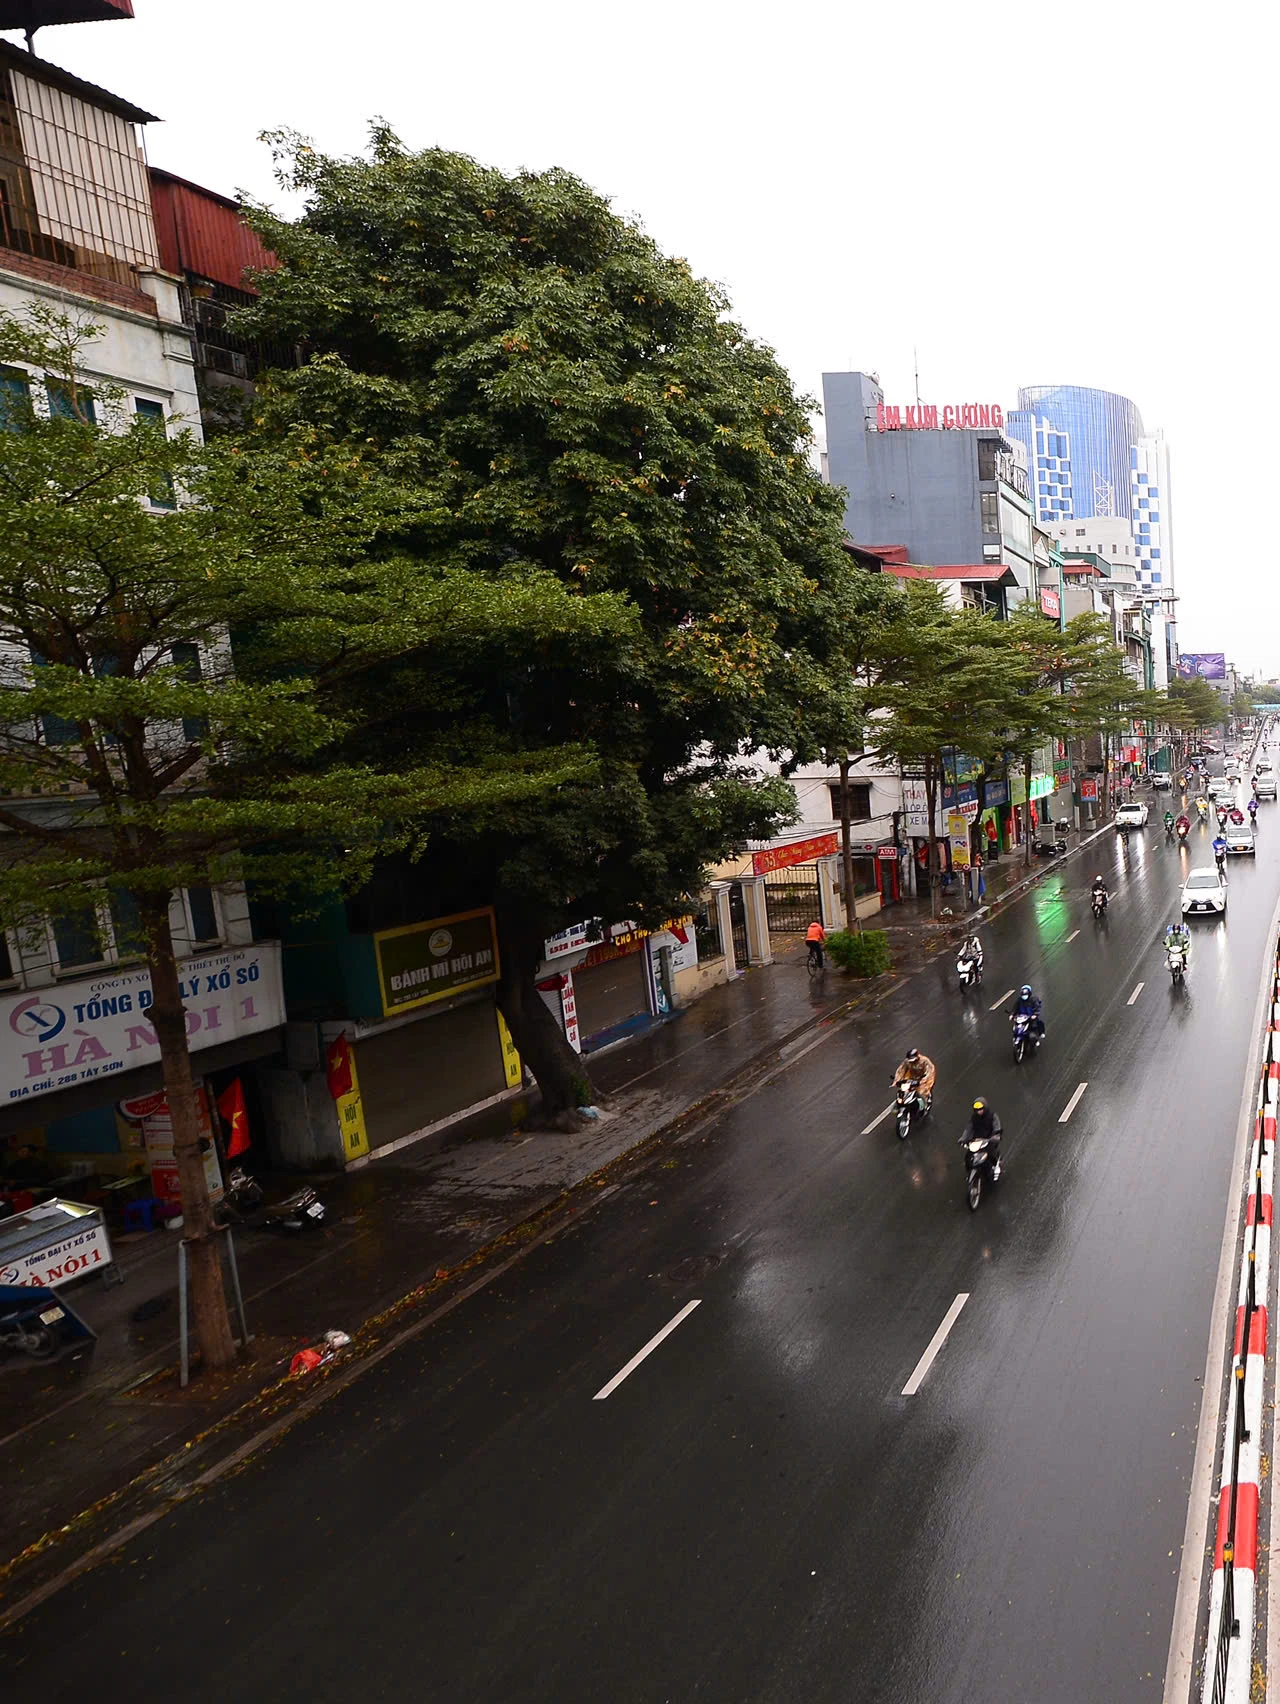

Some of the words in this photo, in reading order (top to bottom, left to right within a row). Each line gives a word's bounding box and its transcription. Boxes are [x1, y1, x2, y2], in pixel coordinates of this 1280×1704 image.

[906, 405, 938, 429] KIM
[943, 402, 1002, 429] CƯƠNG
[904, 789, 925, 800] THAY
[910, 816, 919, 825] XE
[615, 932, 632, 946] CHO
[178, 974, 200, 999] LÝ
[207, 965, 232, 993] XỔ
[236, 959, 260, 985] SỐ
[390, 967, 430, 992] BÁNH
[451, 953, 473, 974] HỘI
[476, 949, 492, 967] AN
[90, 978, 119, 992] CÔNG
[122, 975, 133, 985] TY
[73, 989, 133, 1023] TỔNG
[22, 1028, 112, 1080] HÀ
[240, 996, 259, 1021] 1
[9, 1083, 30, 1099] ĐỊA
[57, 1072, 78, 1086] 288
[80, 1065, 100, 1079] TÂY
[102, 1060, 124, 1072] SƠN
[344, 1103, 357, 1124] HỘI
[350, 1132, 360, 1150] AN
[86, 1231, 97, 1242] SỐ
[46, 1254, 89, 1283] NỘI
[92, 1249, 102, 1263] 1
